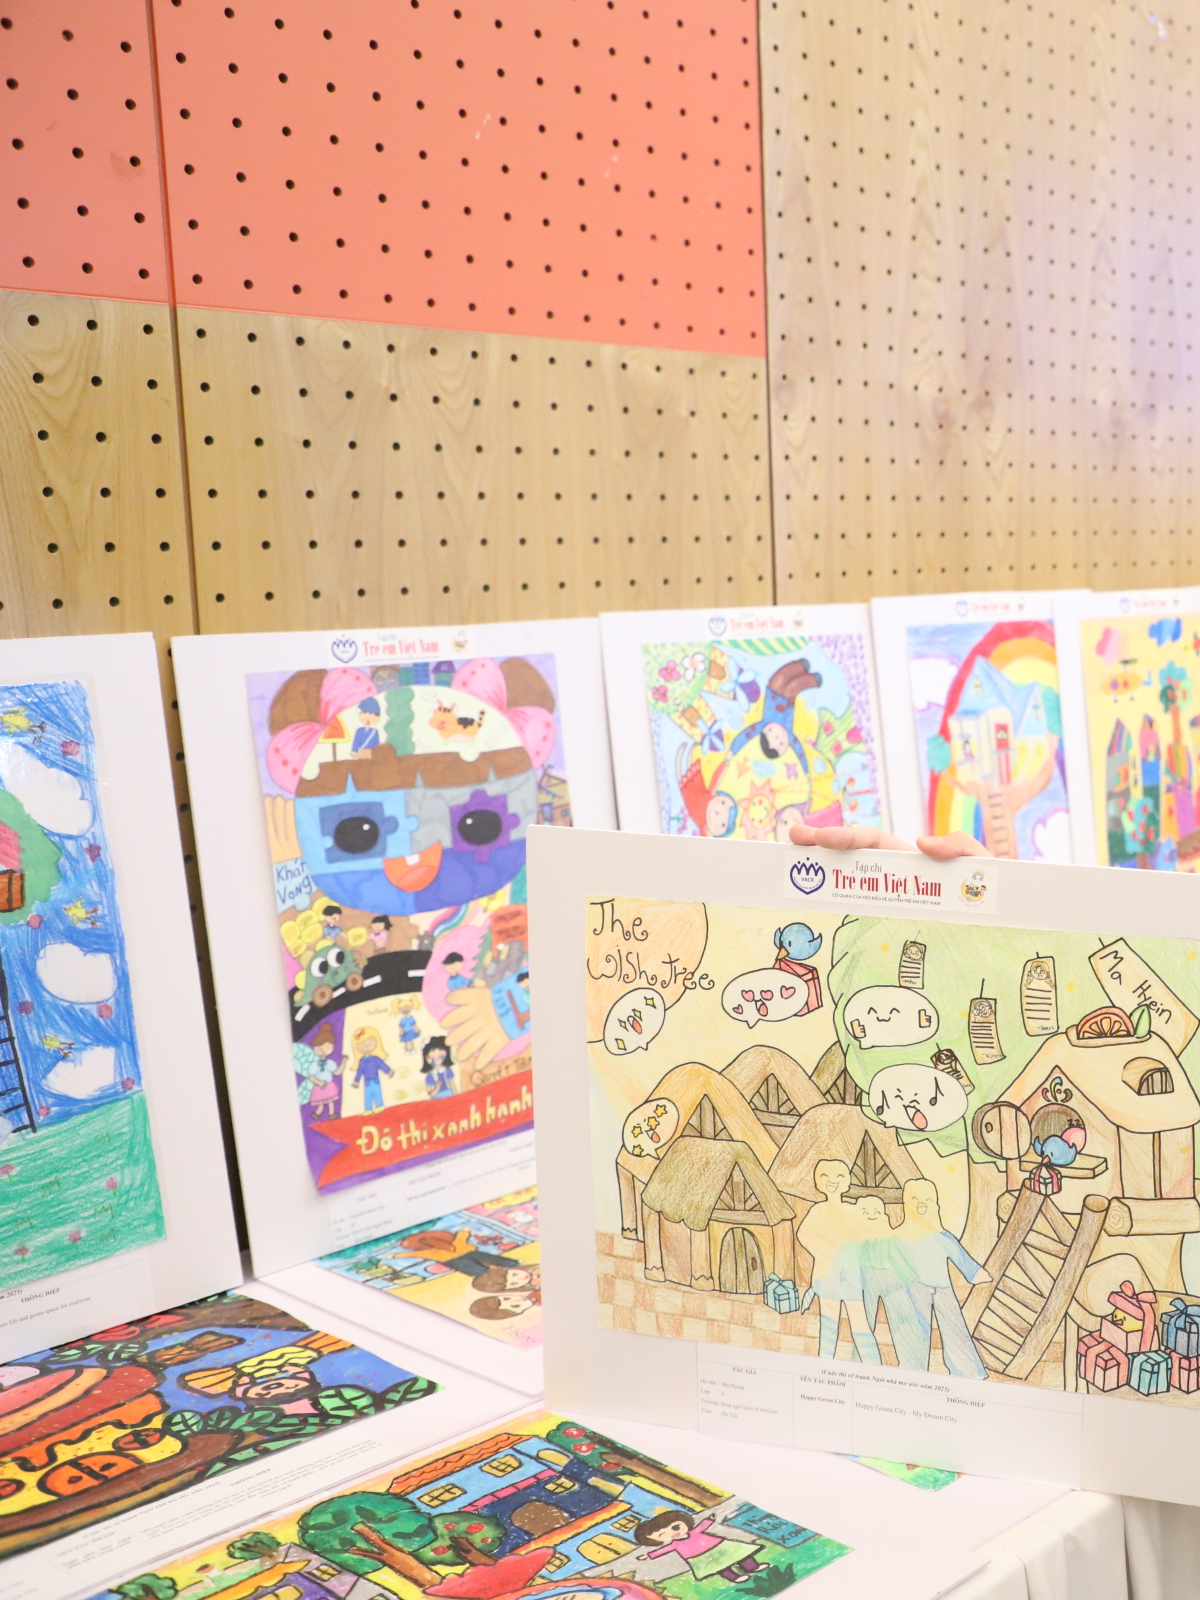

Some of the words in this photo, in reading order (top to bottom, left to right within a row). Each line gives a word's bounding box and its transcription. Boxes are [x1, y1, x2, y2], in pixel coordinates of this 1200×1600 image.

[855, 860, 869, 874] Tạp
[870, 862, 882, 873] chí
[832, 869, 856, 891] Trẻ
[860, 876, 879, 892] em
[883, 872, 909, 898] Việt
[913, 874, 941, 897] Nam
[590, 898, 648, 941] The
[1099, 950, 1124, 985] Ma
[1132, 979, 1172, 1024] Hyein
[356, 1125, 393, 1155] Đô
[397, 1119, 428, 1150] thị
[432, 1104, 482, 1142] xanh
[485, 1085, 532, 1123] hạnh
[800, 1394, 817, 1403] Happy
[818, 1396, 834, 1404] Green
[834, 1397, 845, 1406] City
[933, 1384, 950, 1393] 2025)
[855, 1401, 874, 1412] Happy
[875, 1404, 894, 1413] Green
[894, 1407, 907, 1417] City
[912, 1410, 923, 1419] My
[924, 1412, 944, 1421] Dream
